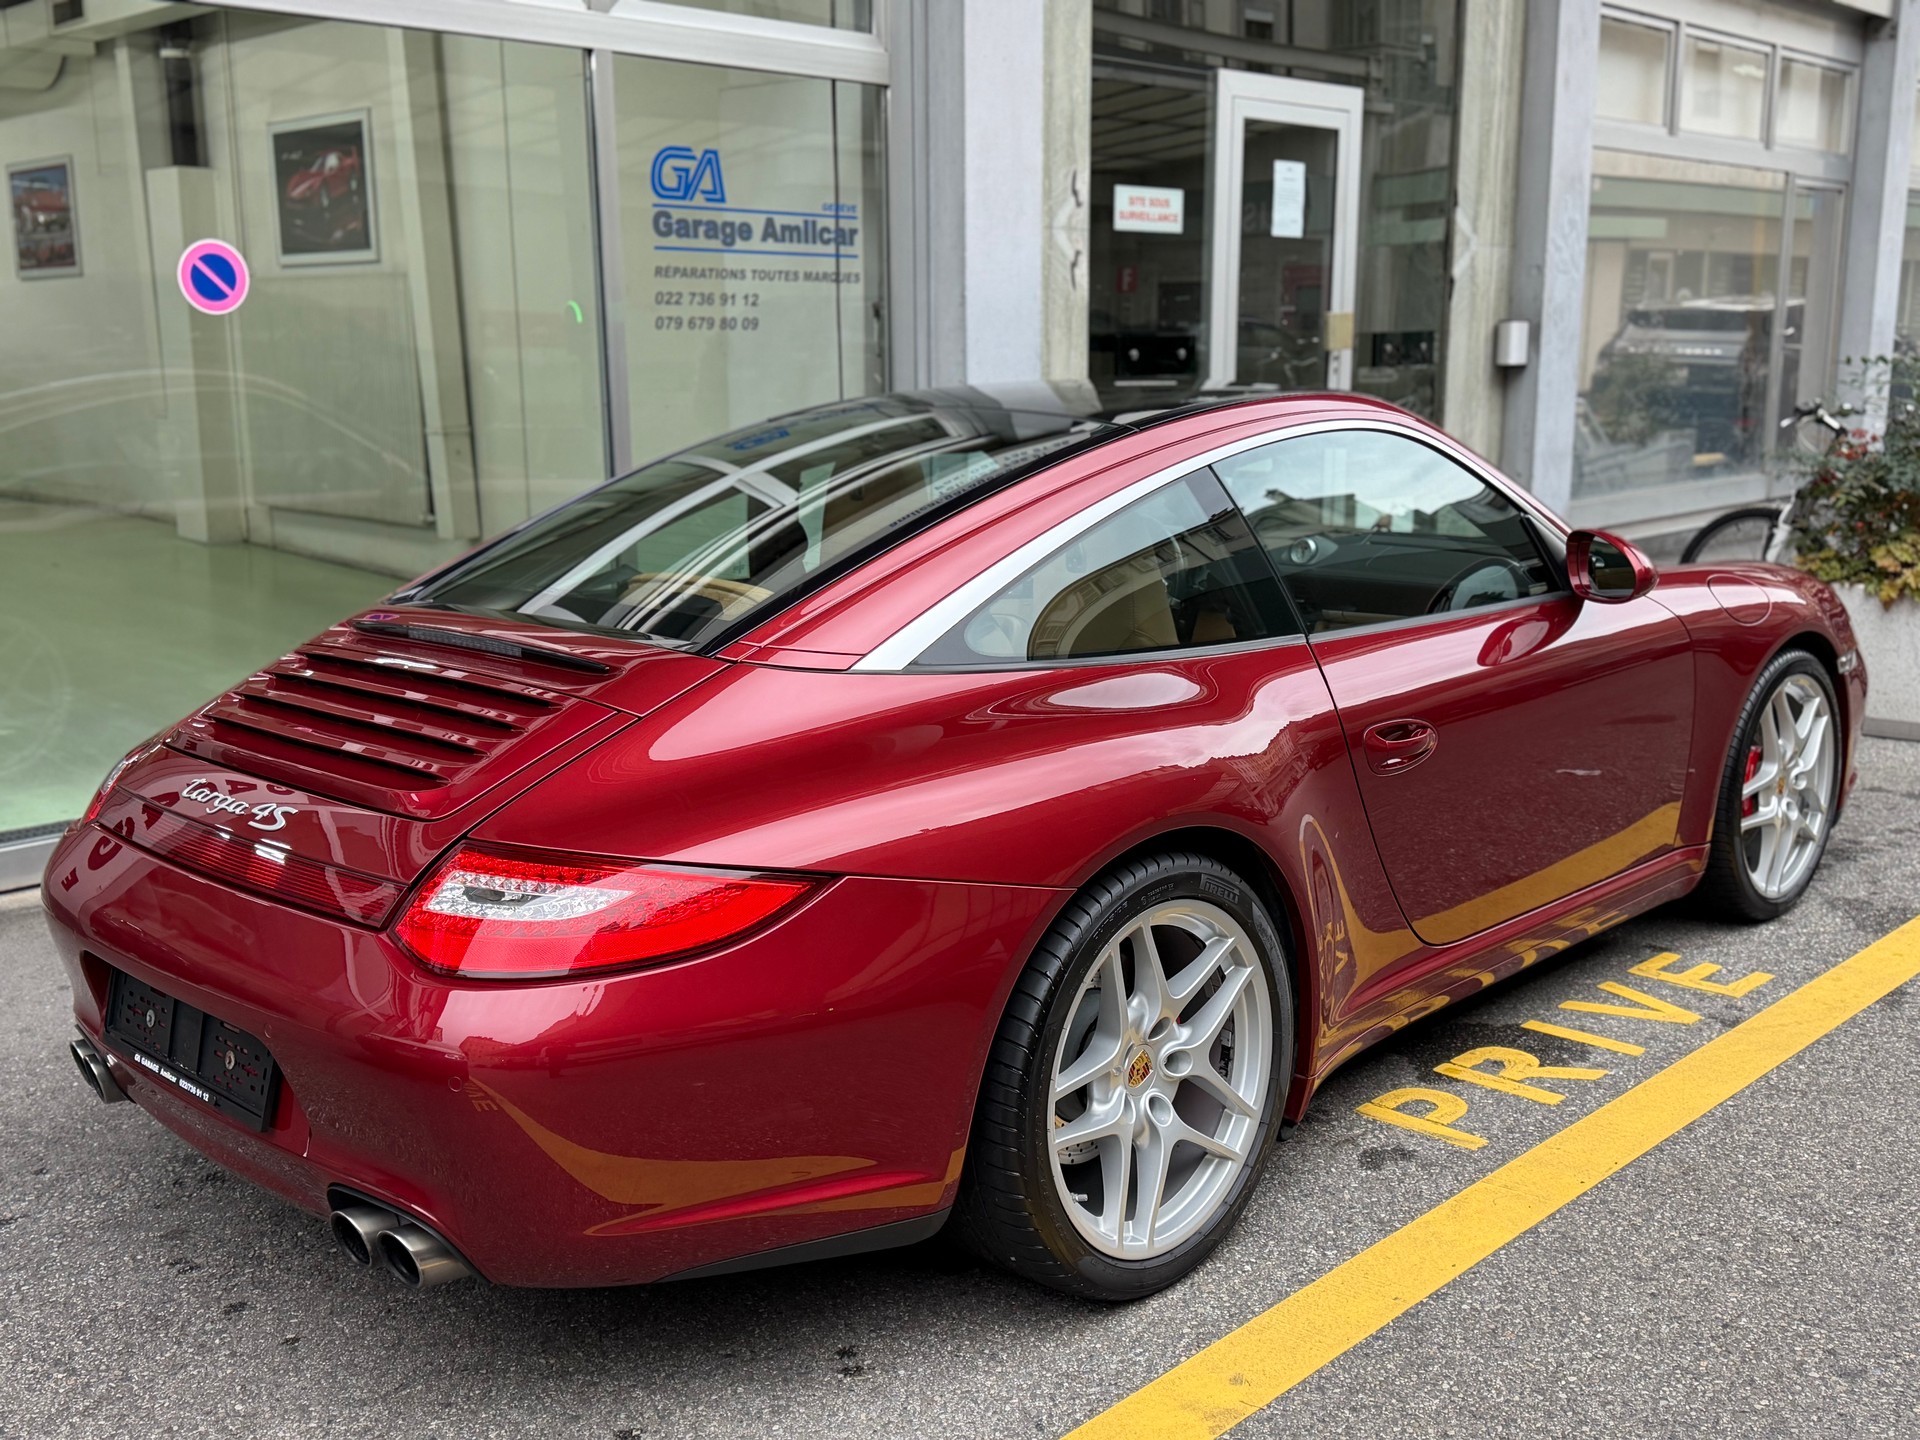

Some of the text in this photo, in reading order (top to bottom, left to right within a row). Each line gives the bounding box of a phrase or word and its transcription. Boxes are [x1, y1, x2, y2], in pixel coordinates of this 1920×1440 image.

[651, 146, 726, 203] GA
[652, 210, 859, 247] Garage Amilcar
[751, 269, 799, 282] TOUTES
[803, 271, 860, 284] MARQUES
[655, 291, 759, 307] 022 736 91 12
[655, 316, 759, 331] 079 679 80 09
[248, 803, 299, 831] 4S
[1200, 873, 1240, 905] PIRELLI
[1355, 951, 1776, 1150] PRIVE
[141, 1057, 160, 1073] GARAGE
